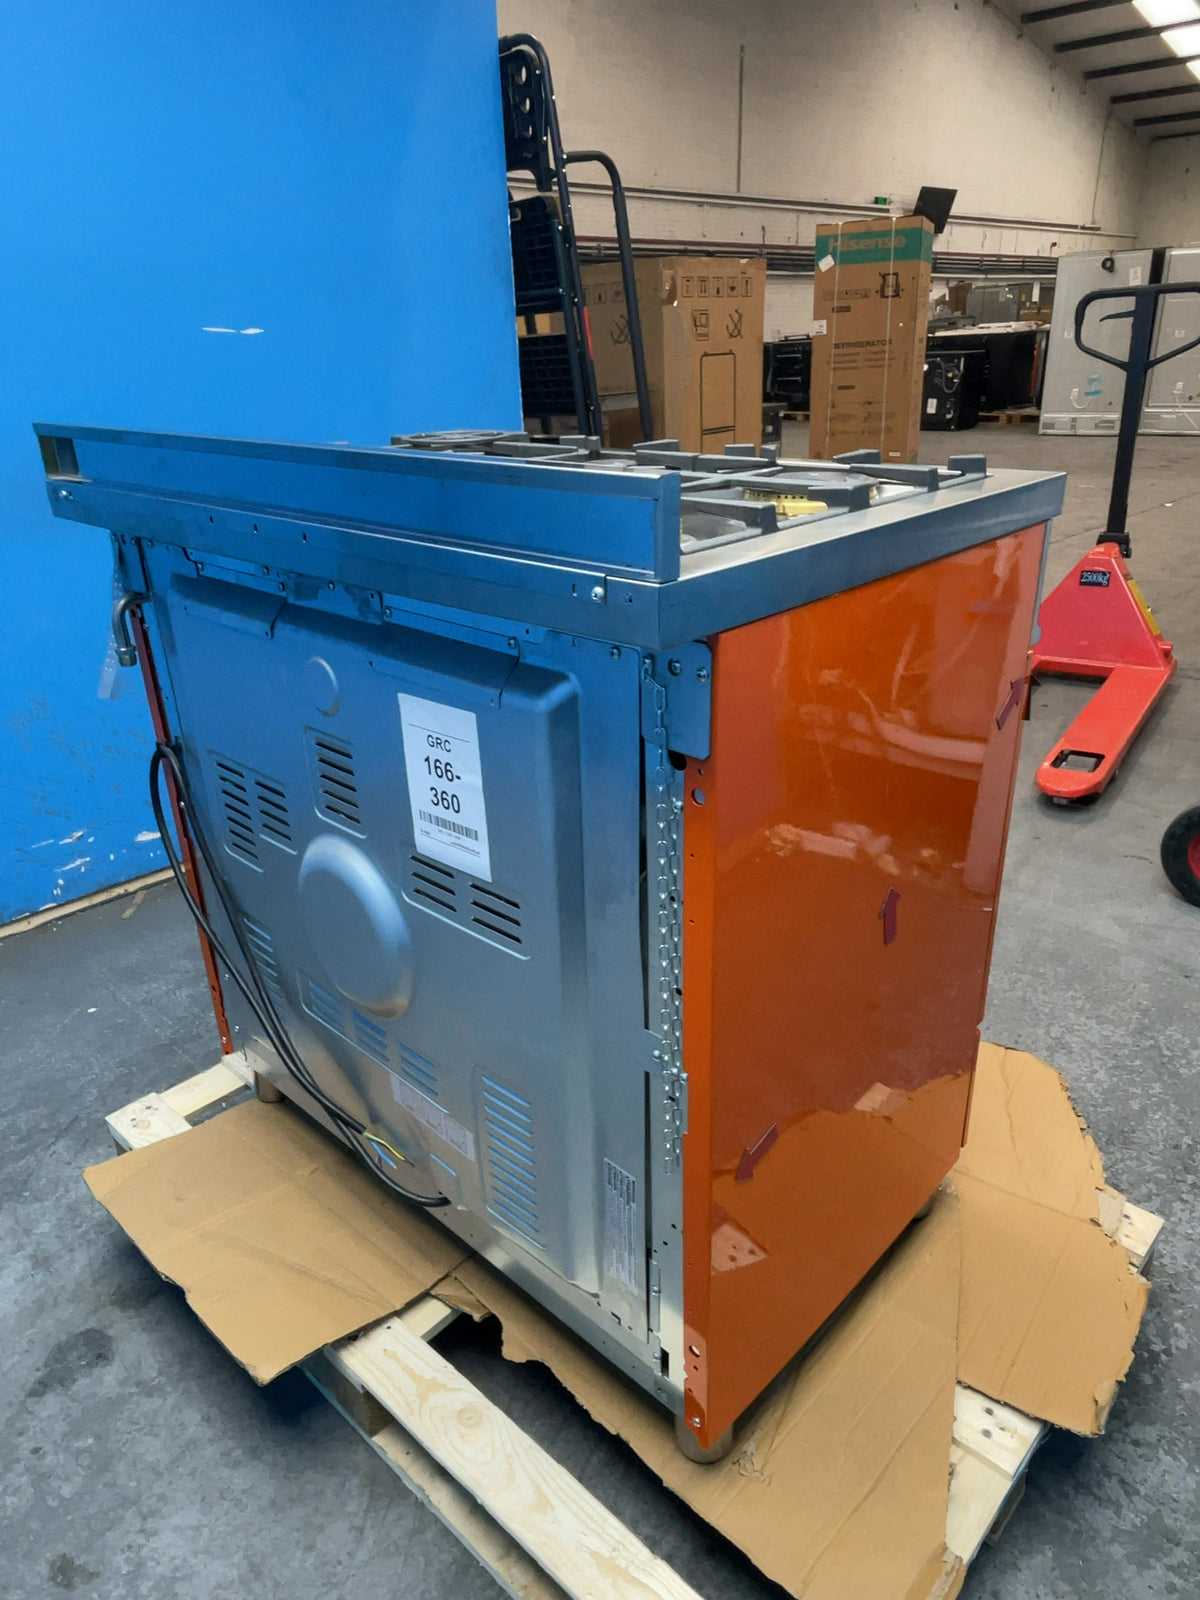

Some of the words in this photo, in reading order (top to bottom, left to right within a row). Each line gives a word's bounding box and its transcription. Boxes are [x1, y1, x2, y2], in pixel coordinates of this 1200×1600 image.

[828, 235, 906, 252] Hisense
[426, 734, 452, 753] GRC
[424, 755, 461, 782] 166-
[430, 786, 461, 814] 360
